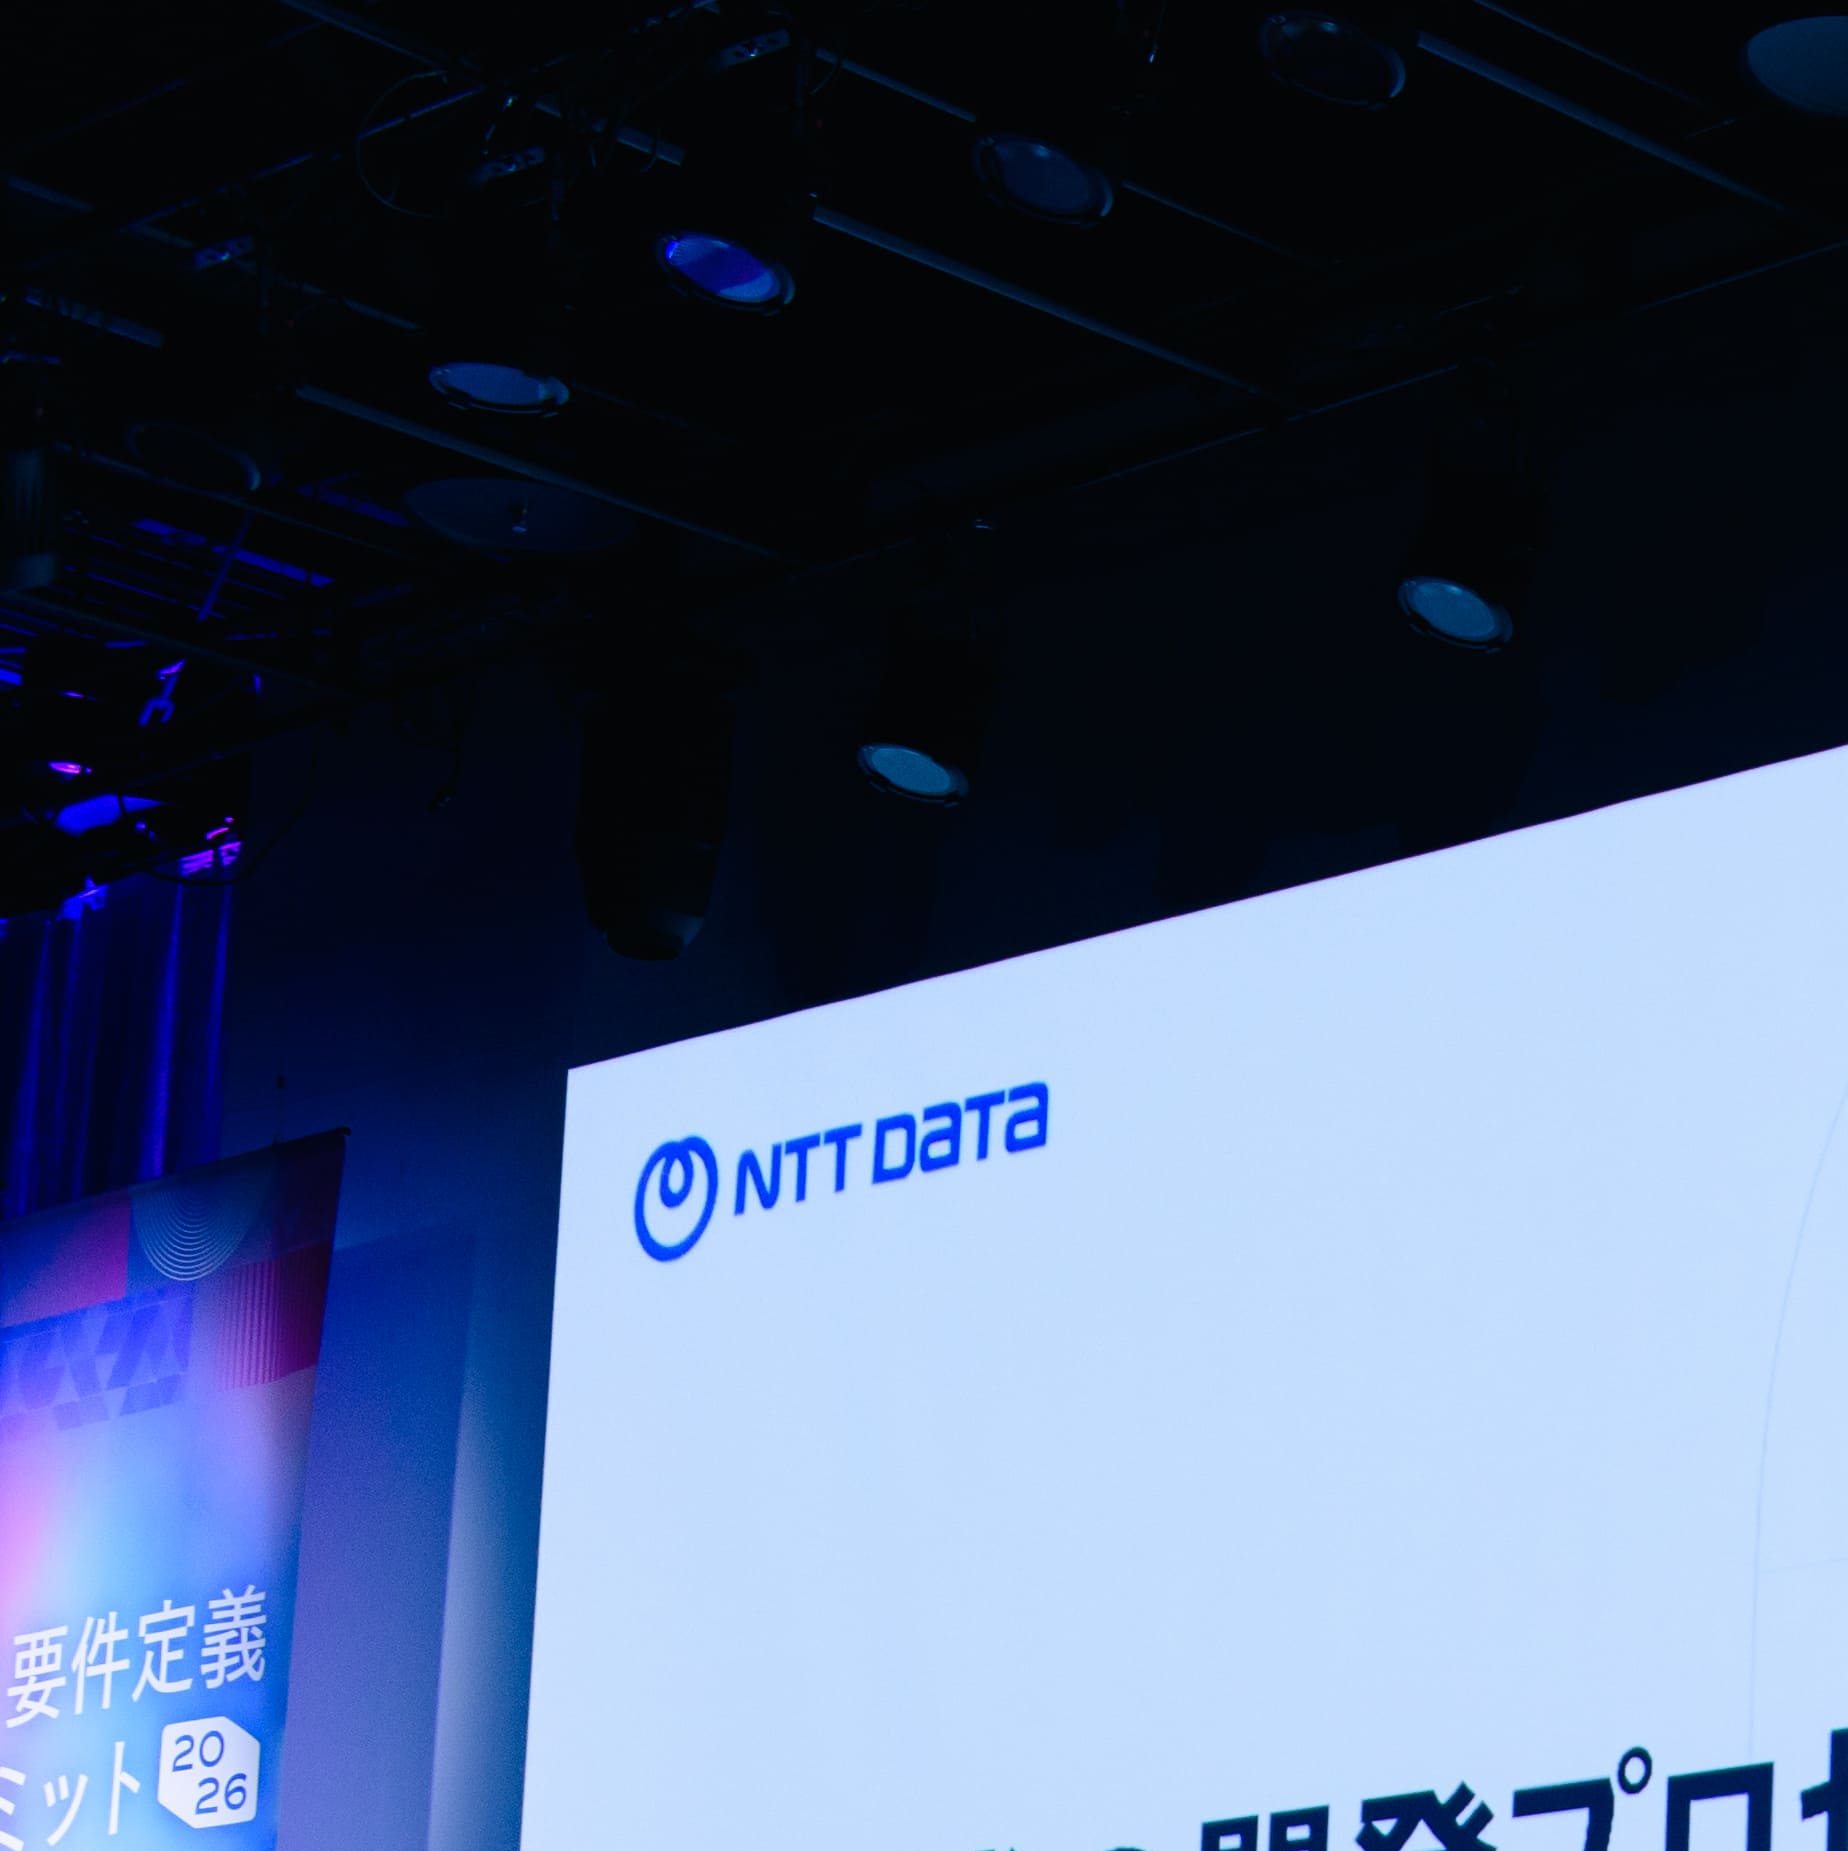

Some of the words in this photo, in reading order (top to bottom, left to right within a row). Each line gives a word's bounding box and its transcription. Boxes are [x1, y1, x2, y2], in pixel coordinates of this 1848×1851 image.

[733, 1123, 863, 1216] NTT
[6, 1584, 268, 1728] 要件定義
[172, 1730, 225, 1772] 20
[195, 1772, 248, 1814] 26
